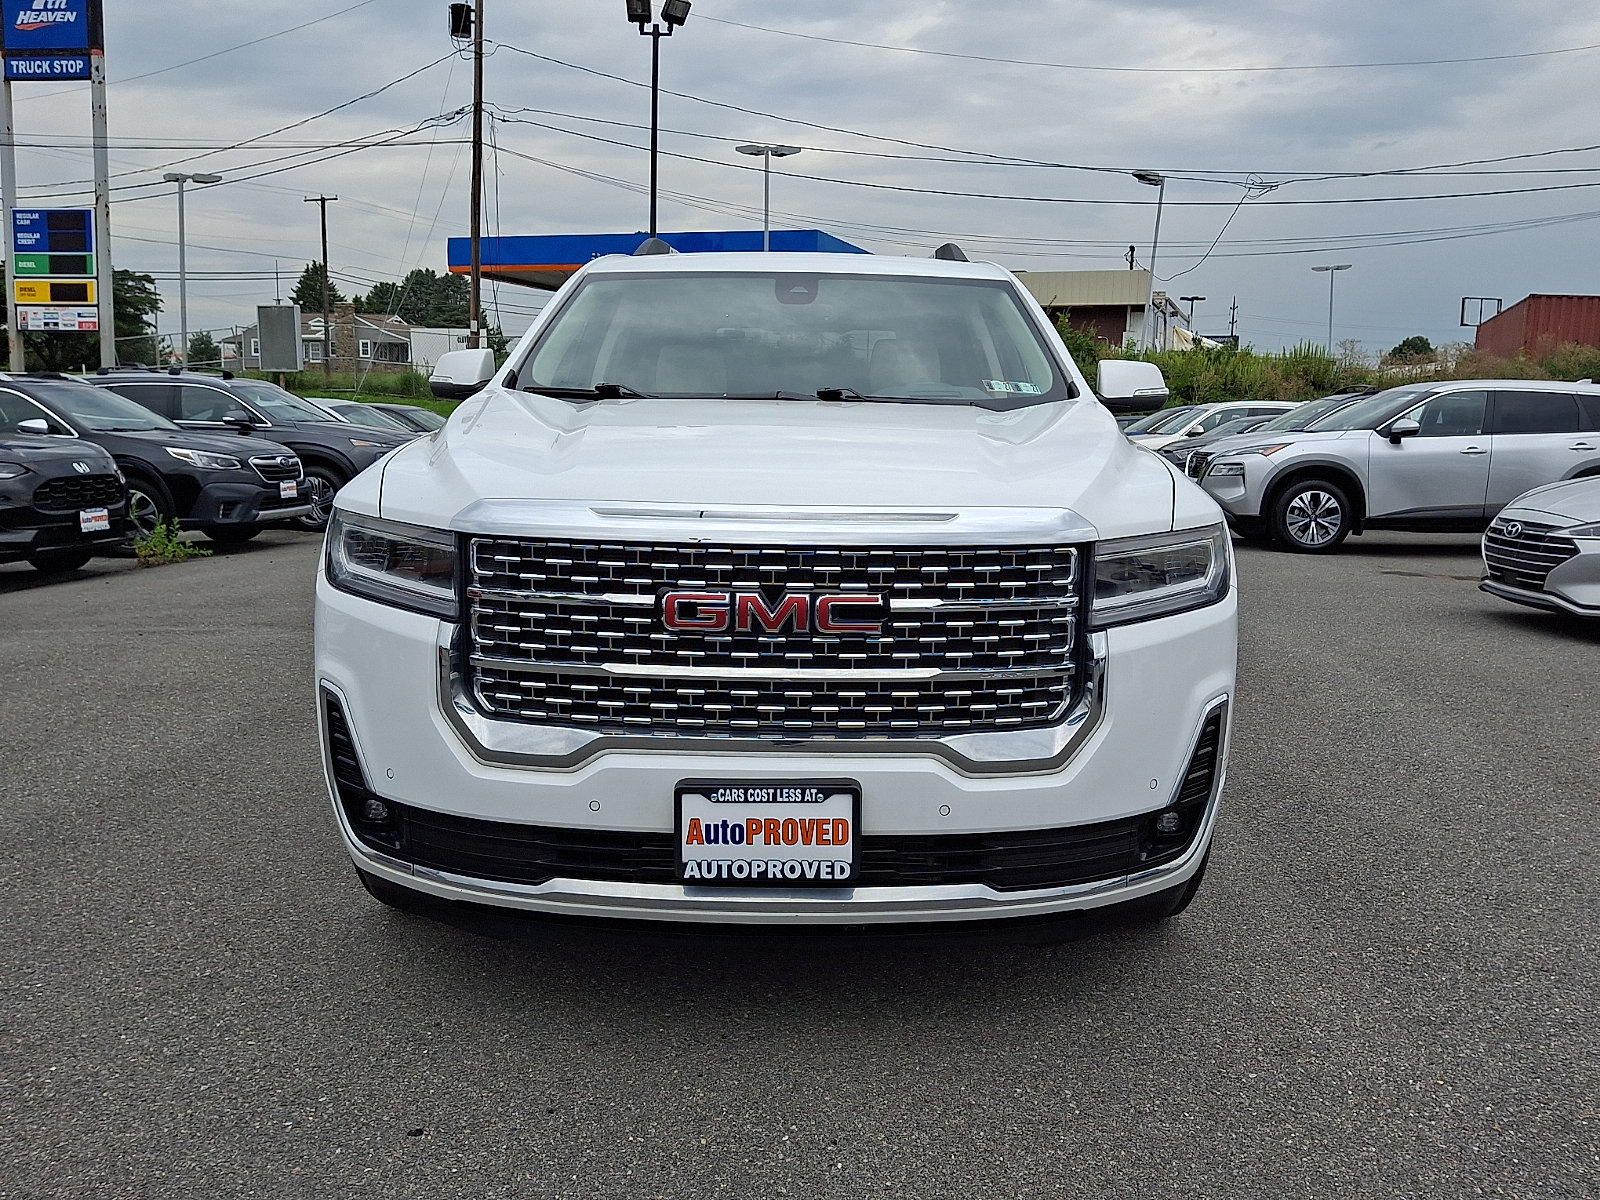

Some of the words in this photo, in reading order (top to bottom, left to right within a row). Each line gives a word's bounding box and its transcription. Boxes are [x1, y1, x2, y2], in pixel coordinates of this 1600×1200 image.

[16, 11, 77, 24] HEAVEN
[11, 60, 51, 74] TRUCK
[53, 60, 84, 73] STOP
[662, 592, 883, 633] GMC
[717, 789, 745, 802] CARS
[747, 789, 775, 801] COST
[776, 789, 802, 801] LESS
[804, 789, 818, 801] AT
[686, 818, 849, 846] AutoPROVED
[684, 860, 851, 879] AUTOPROVED
